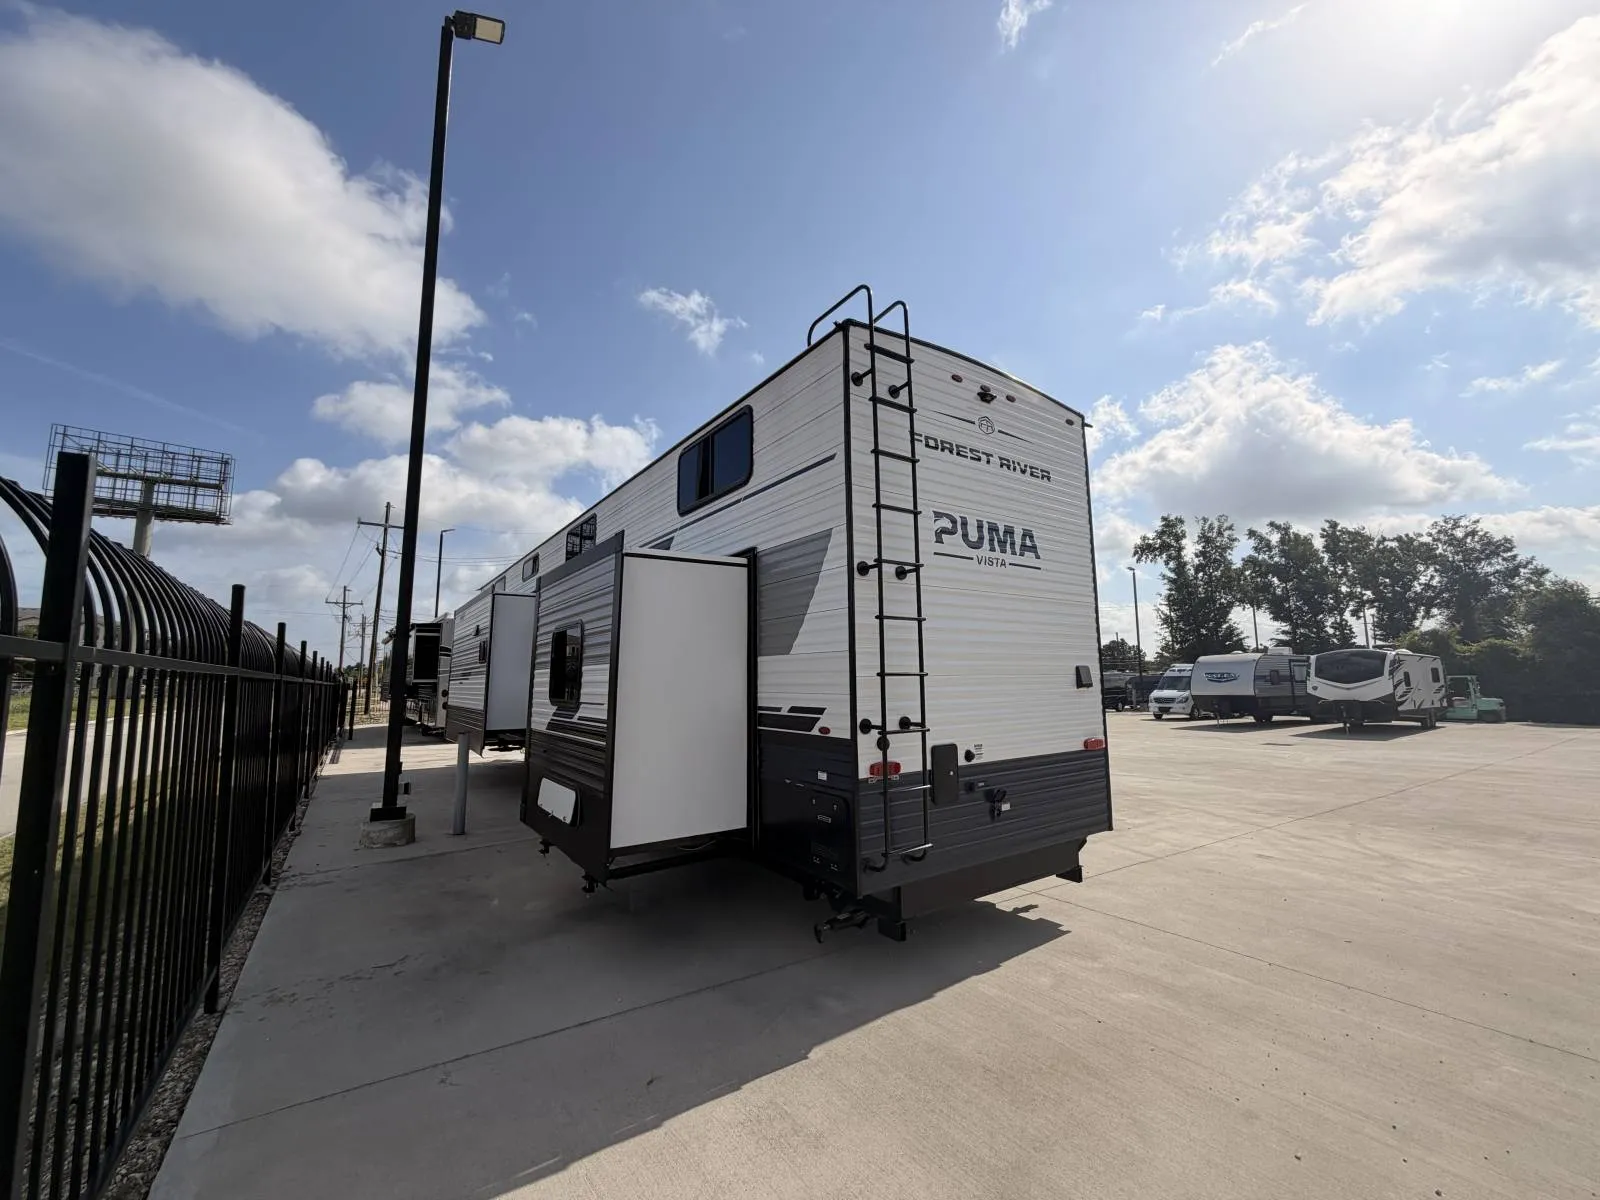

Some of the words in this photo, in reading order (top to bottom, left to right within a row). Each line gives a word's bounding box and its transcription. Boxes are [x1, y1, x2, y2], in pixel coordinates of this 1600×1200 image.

[998, 455, 1052, 482] RIVER
[932, 510, 1041, 560] PUMA
[976, 555, 1007, 569] VISTA
